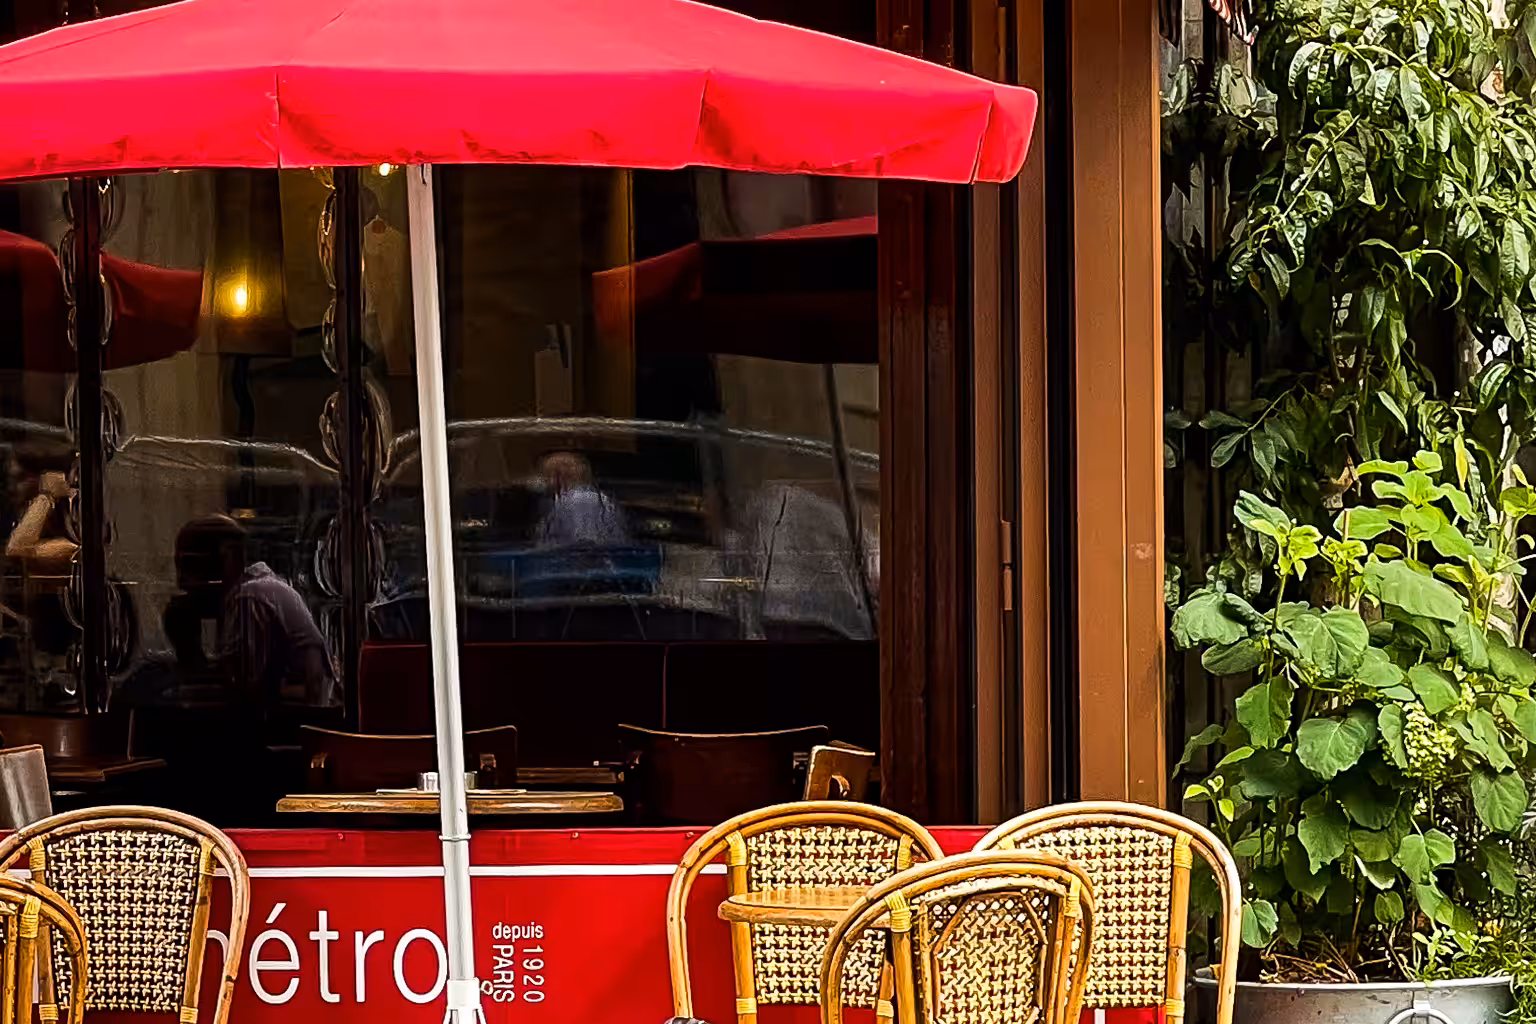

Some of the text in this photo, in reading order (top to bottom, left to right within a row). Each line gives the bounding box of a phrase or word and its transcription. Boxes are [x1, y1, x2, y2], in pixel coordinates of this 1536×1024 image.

[208, 902, 449, 1005] étro
[491, 921, 544, 943] depuis
[491, 944, 515, 1003] PARIS
[522, 944, 545, 1003] 1920
